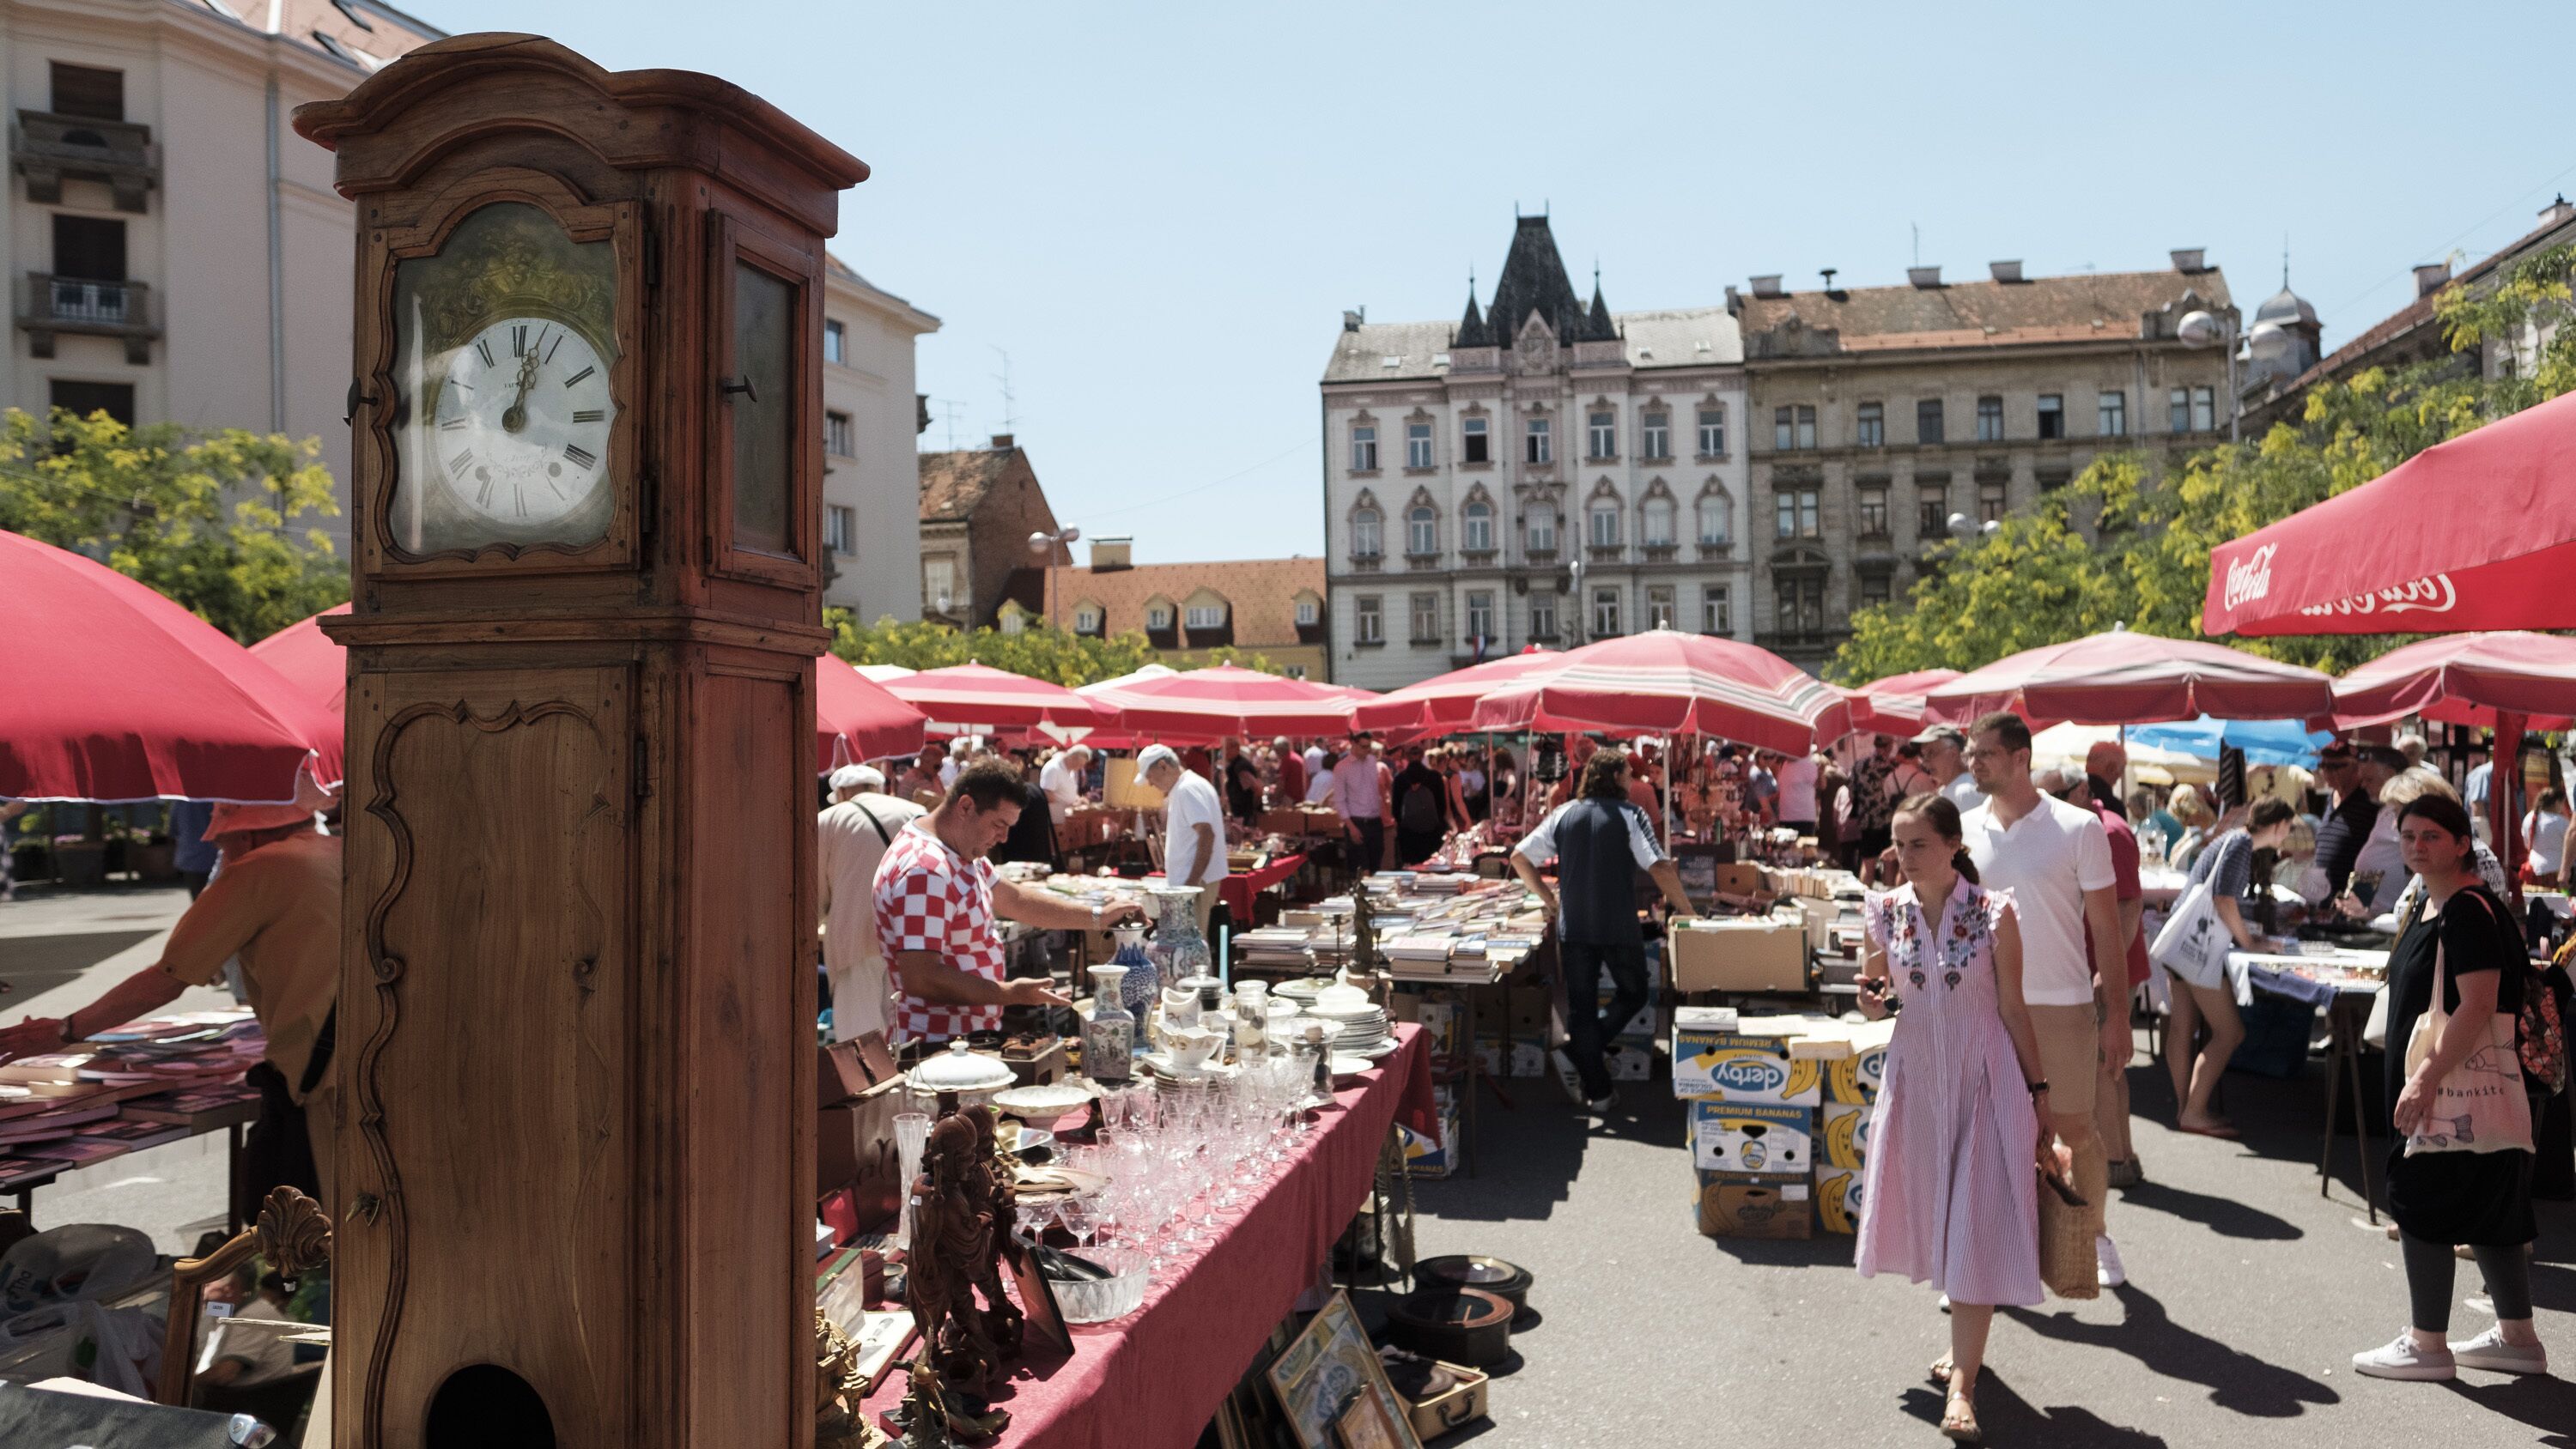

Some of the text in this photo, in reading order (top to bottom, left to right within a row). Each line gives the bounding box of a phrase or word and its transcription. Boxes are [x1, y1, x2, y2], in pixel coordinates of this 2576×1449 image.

[1717, 1061, 1779, 1090] derby
[1706, 1106, 1802, 1119] PREMIUM BANANAS
